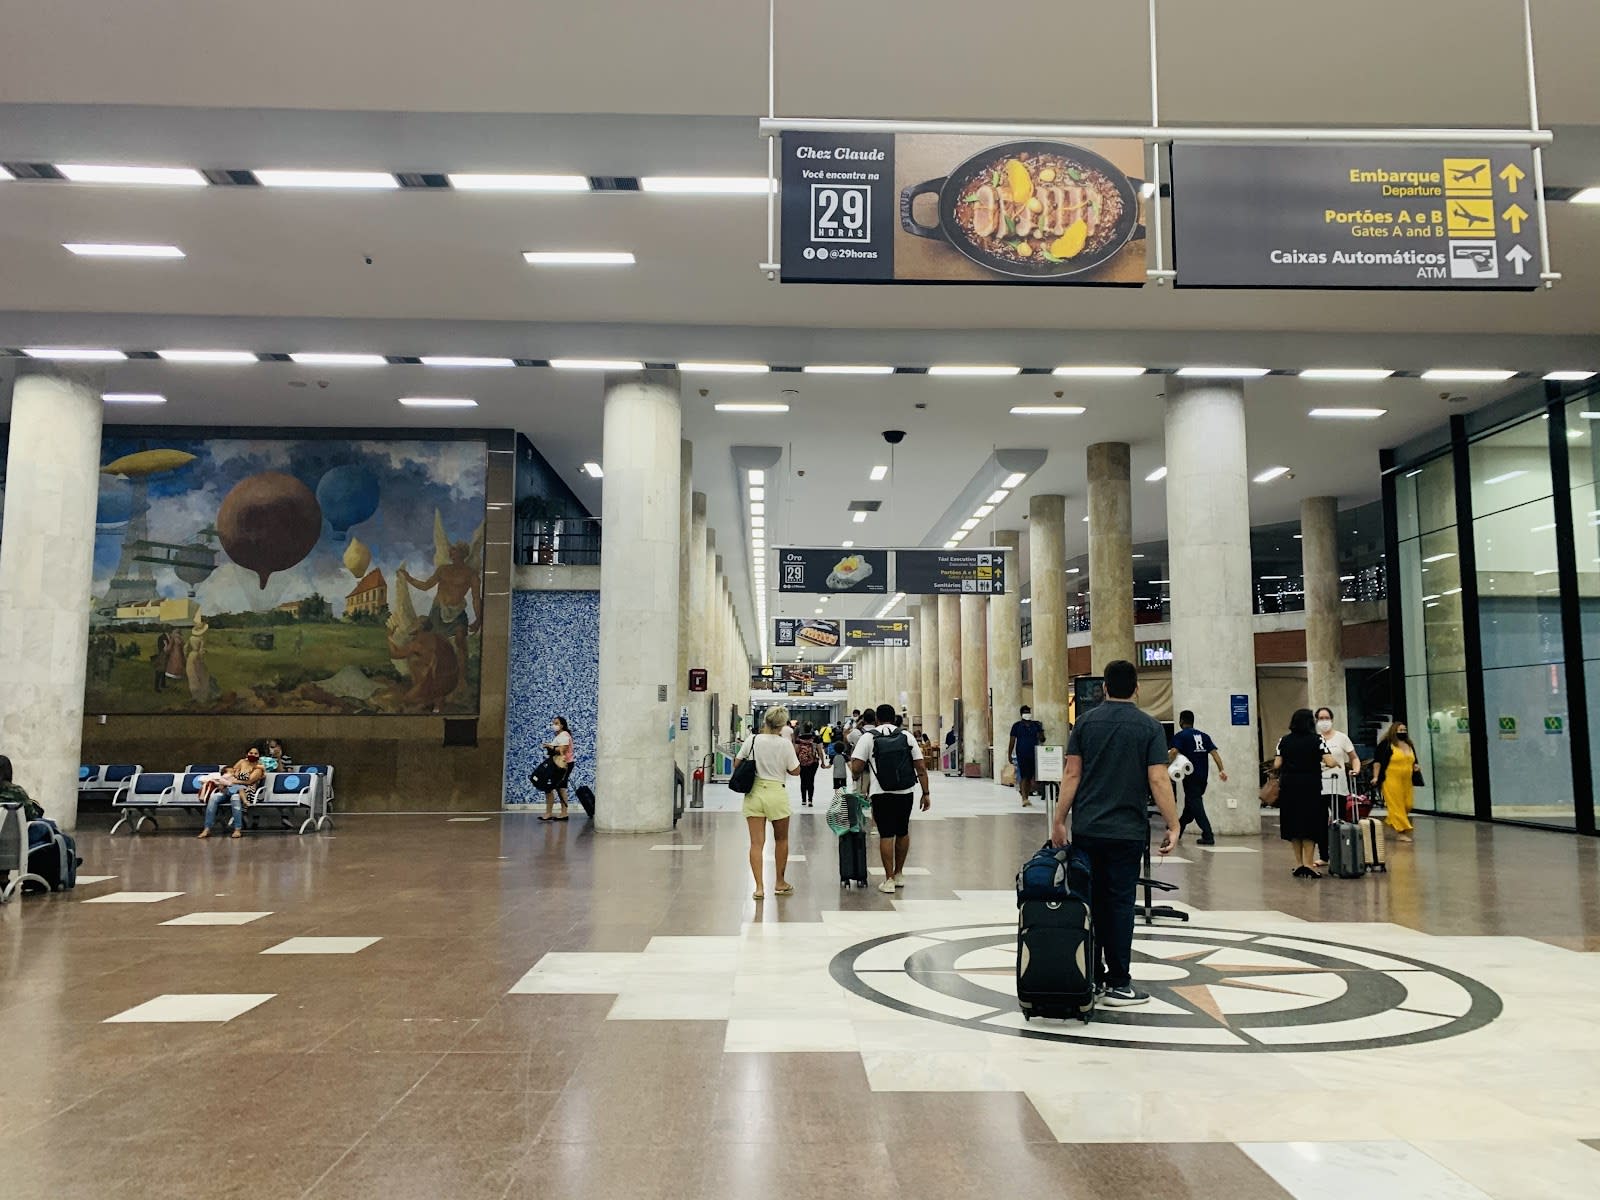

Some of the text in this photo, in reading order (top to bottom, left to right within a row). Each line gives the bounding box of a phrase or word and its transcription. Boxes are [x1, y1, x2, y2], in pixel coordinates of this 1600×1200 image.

[796, 146, 885, 160] Chez Claude
[802, 169, 824, 179] Você
[825, 171, 866, 180] encontra
[1350, 168, 1441, 185] Embarque
[1382, 185, 1442, 198] Departure
[818, 189, 864, 229] 29
[1325, 209, 1443, 224] Portões A e B
[818, 229, 863, 238] HORAS
[1351, 225, 1444, 238] Gates A and B
[829, 249, 878, 260] @29horas
[1270, 249, 1446, 265] Caixas Automáticos
[1416, 267, 1447, 279] ATM
[788, 567, 802, 579] 29
